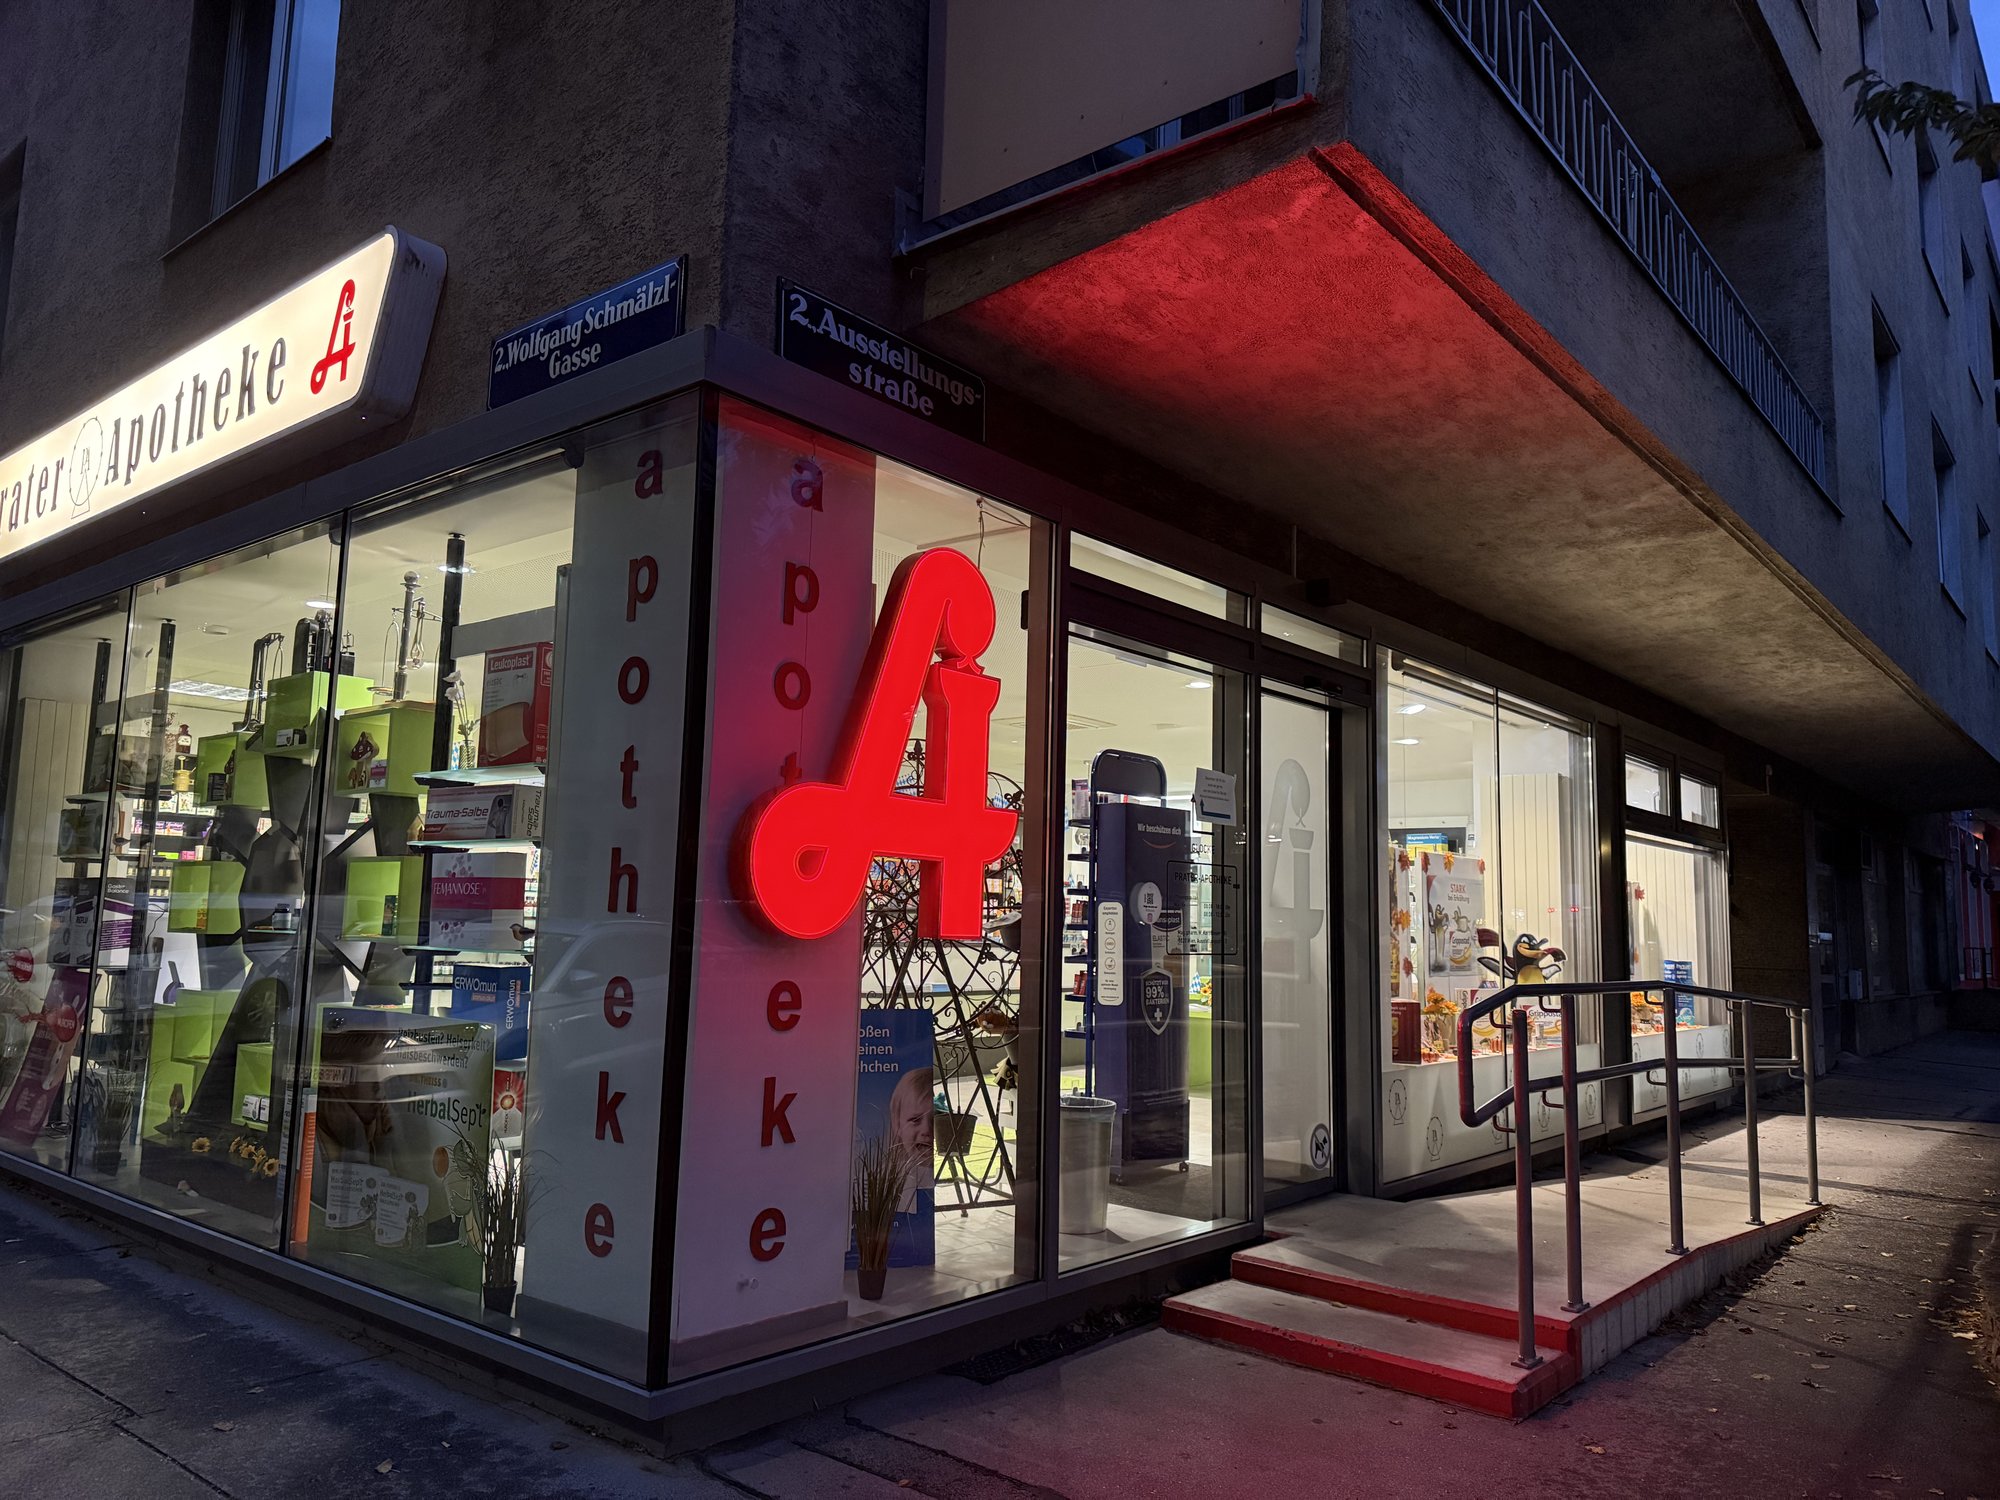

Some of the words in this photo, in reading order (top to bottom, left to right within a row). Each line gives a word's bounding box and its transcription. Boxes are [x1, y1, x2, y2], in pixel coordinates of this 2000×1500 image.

[584, 274, 677, 334] Schmälzl-
[549, 343, 602, 379] Gasse
[848, 361, 934, 416] straße
[104, 337, 287, 487] Apotheke
[490, 654, 530, 671] Leukoplast
[427, 806, 489, 819] Trauma-Salbe
[749, 456, 824, 1262] apoteke
[433, 882, 480, 896] FEMANNOSE
[1450, 883, 1466, 894] STARK
[454, 976, 497, 992] ERWOmun
[1146, 985, 1165, 998] 99%
[505, 979, 516, 1030] ERWOmun
